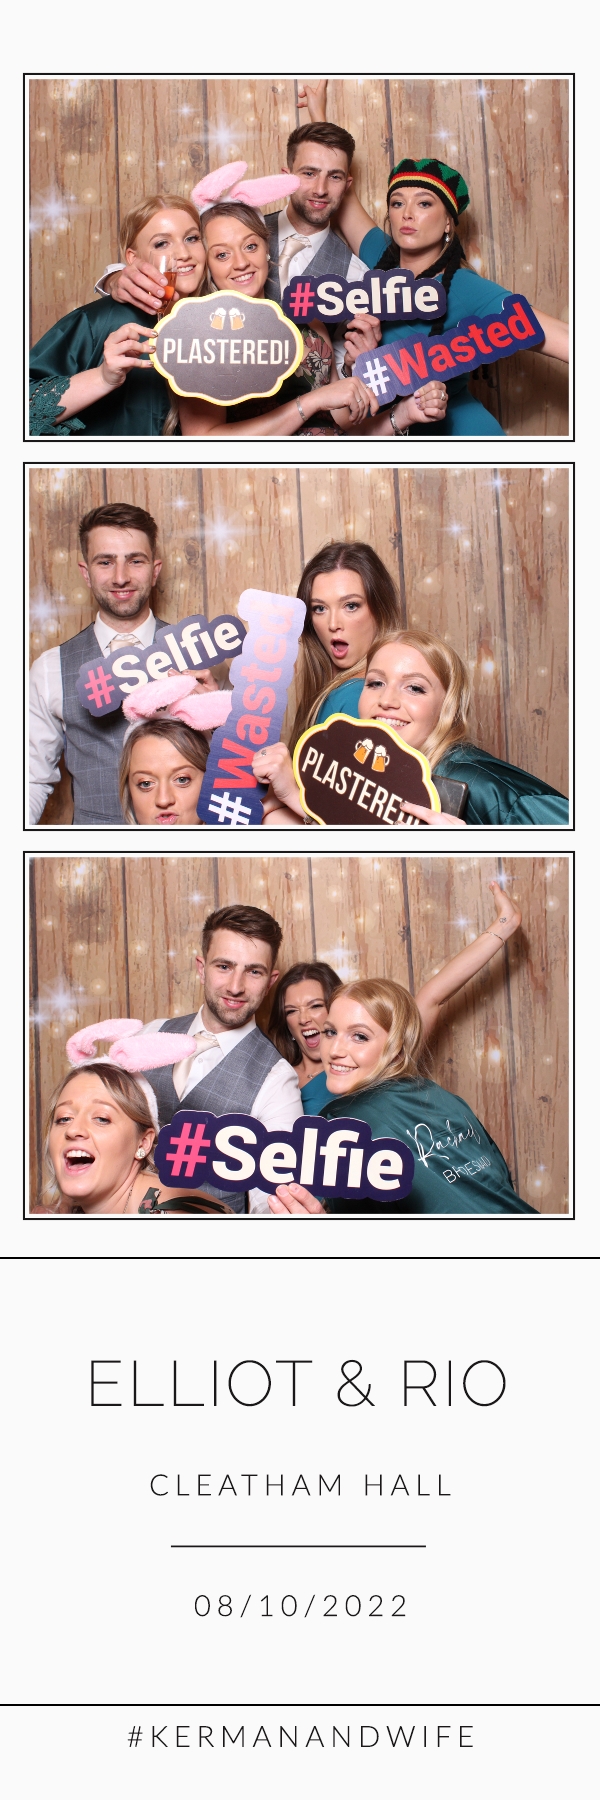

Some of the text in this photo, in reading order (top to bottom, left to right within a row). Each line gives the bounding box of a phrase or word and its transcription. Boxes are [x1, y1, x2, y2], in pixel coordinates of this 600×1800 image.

[289, 275, 439, 317] #Selfie
[162, 337, 290, 366] PLASTERED!
[362, 301, 537, 398] #Wasted
[84, 620, 243, 709] #Selfie
[207, 601, 295, 825] #Wasted
[165, 1122, 404, 1191] #Selfie
